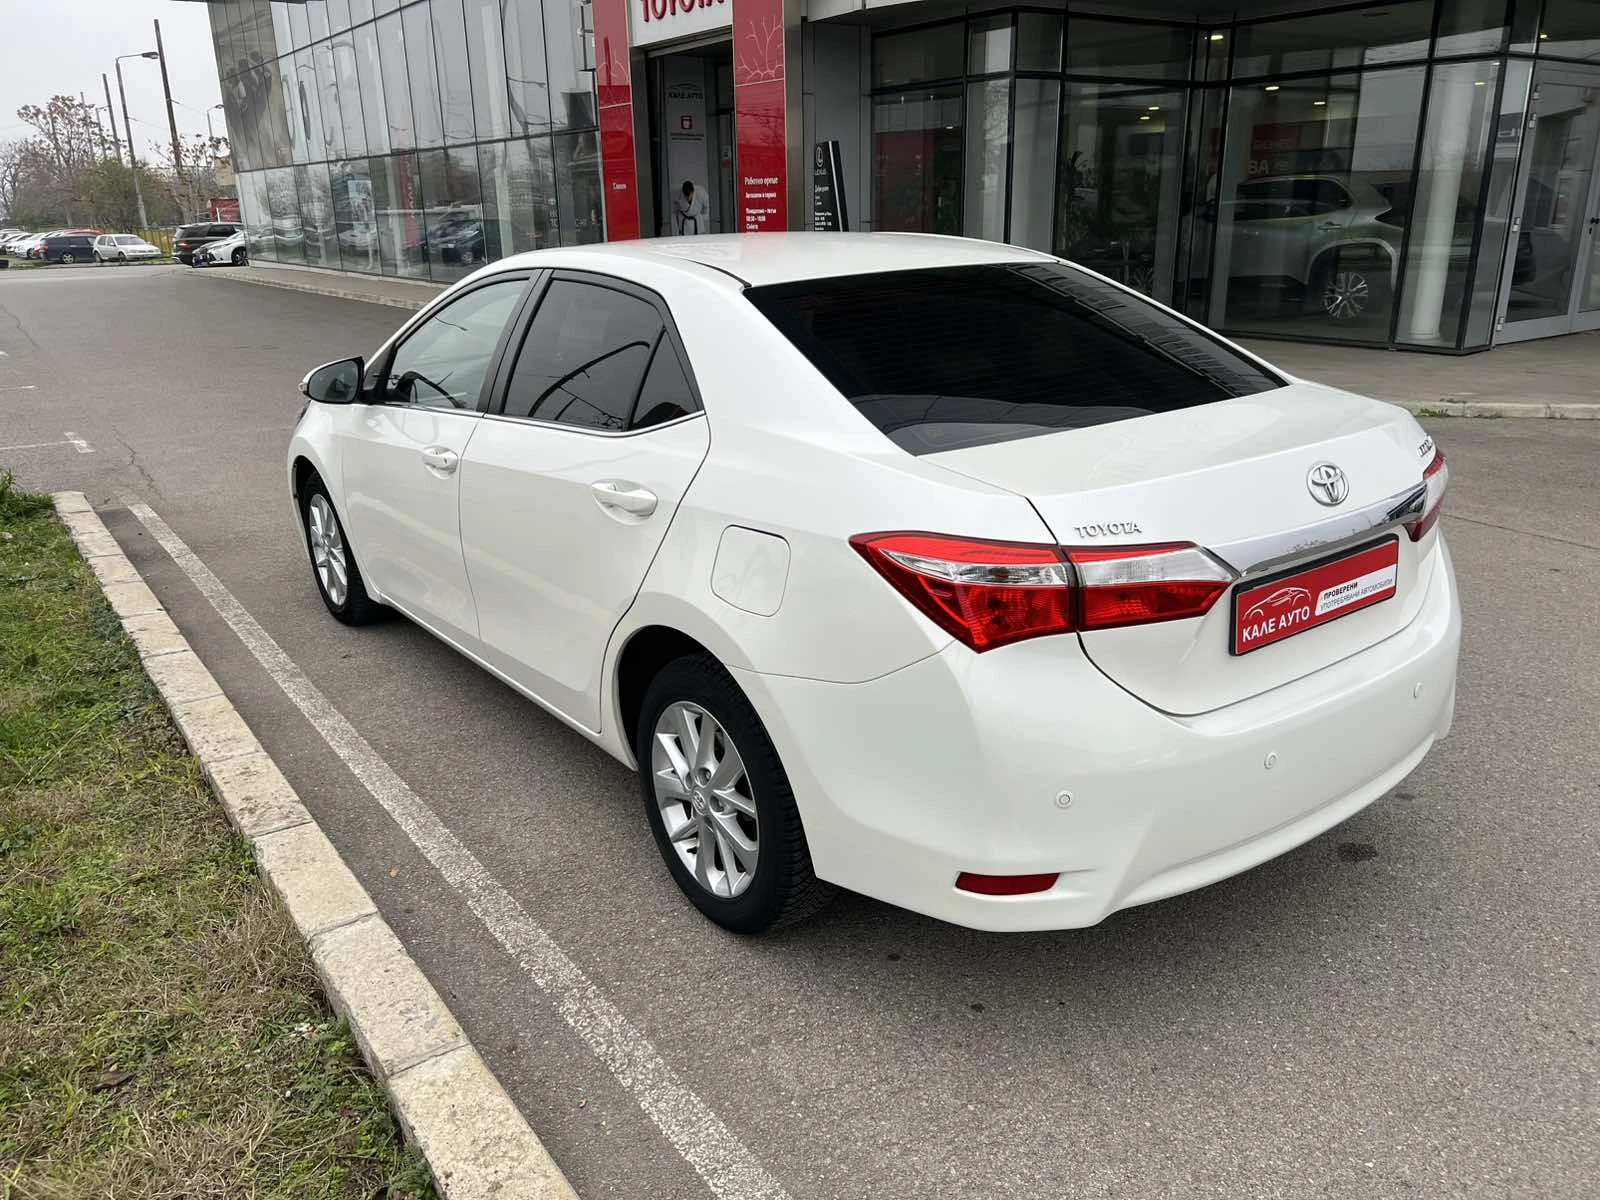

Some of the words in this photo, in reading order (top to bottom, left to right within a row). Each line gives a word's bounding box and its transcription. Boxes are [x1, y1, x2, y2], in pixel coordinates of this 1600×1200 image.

[641, 0, 725, 22] TOYO
[1074, 521, 1142, 538] TOYOTA
[1323, 581, 1358, 600] ПРОВЕРЕНИ
[1360, 577, 1393, 597] АВТОМОБИЛИ
[1242, 618, 1276, 643] КАЛЕ
[1278, 606, 1310, 630] АУТО
